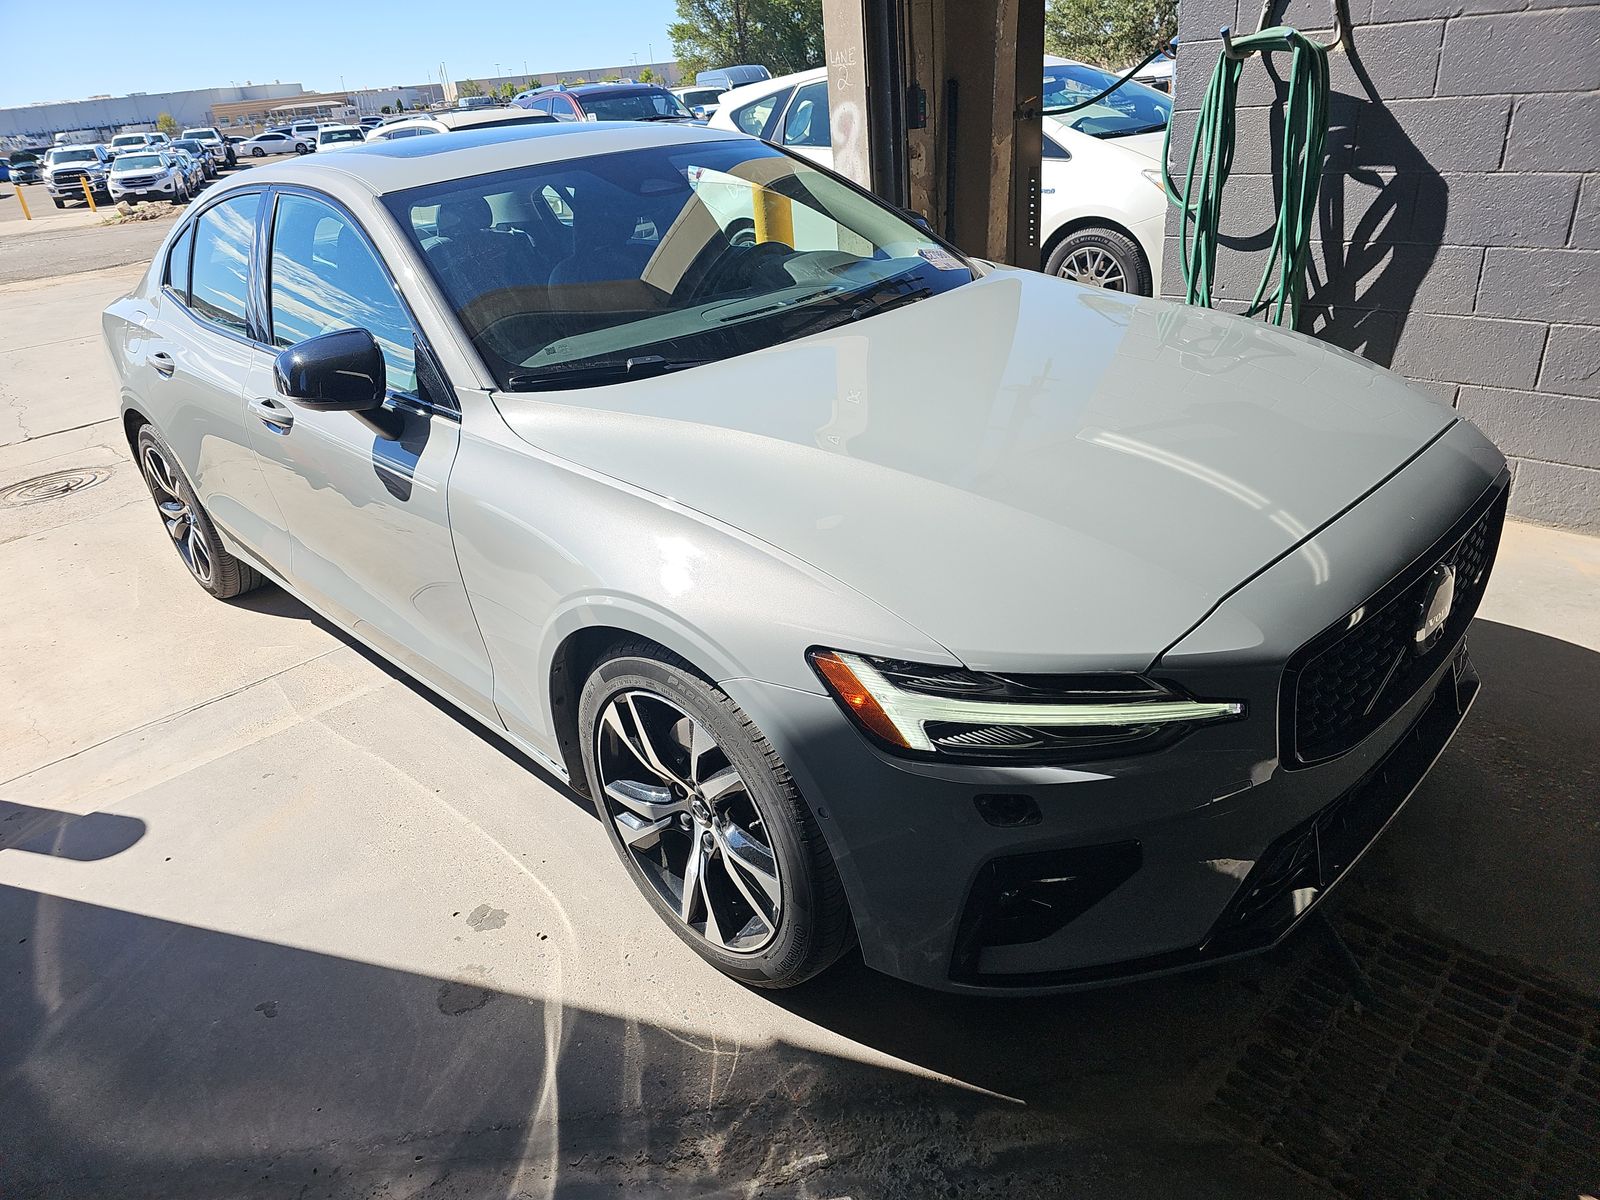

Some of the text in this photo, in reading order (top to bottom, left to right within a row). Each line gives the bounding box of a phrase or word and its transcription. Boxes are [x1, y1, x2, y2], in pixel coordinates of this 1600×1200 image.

[829, 46, 856, 65] LANE
[837, 65, 854, 91] 2
[1080, 235, 1108, 245] MICHELIN
[781, 923, 808, 975] Continental
